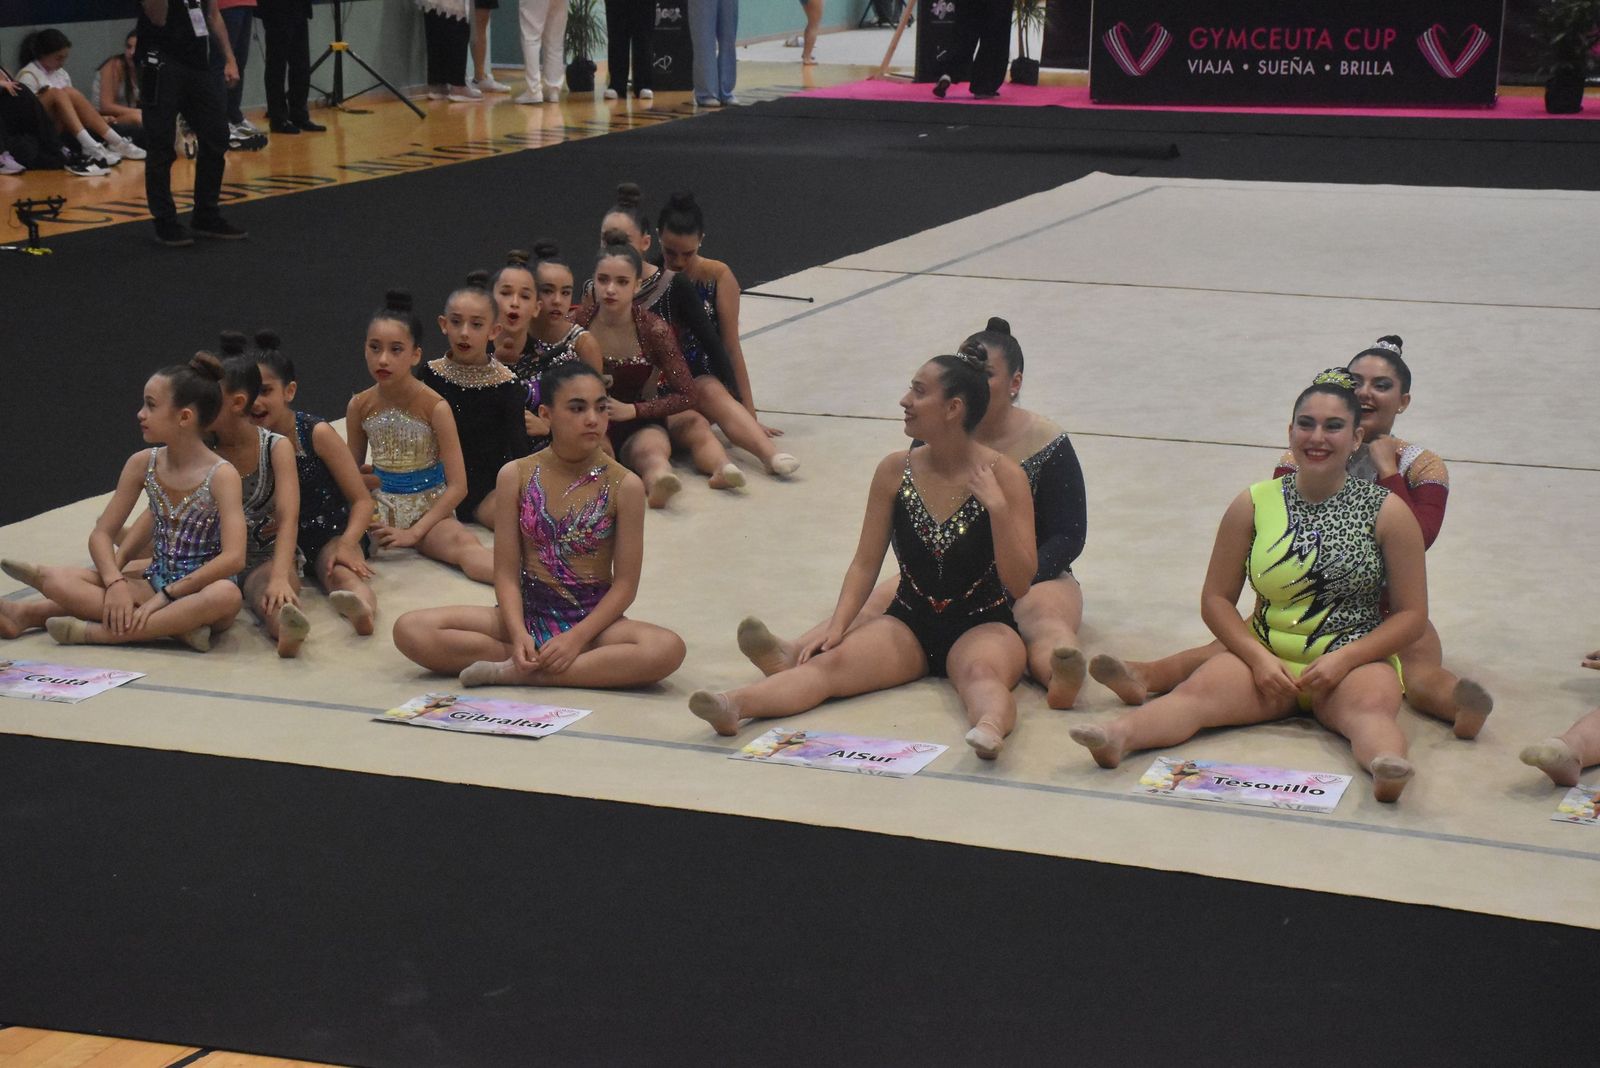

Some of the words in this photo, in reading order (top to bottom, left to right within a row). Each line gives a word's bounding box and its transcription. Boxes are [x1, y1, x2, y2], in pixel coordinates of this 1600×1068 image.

[1188, 26, 1333, 51] GYMCEUTA
[1344, 27, 1398, 51] CUP
[1187, 59, 1235, 75] VIAJA
[1257, 56, 1316, 75] SUEÑA
[1340, 60, 1395, 76] BRILLA
[23, 674, 89, 686] Ceuta
[449, 711, 555, 730] Gibraltar
[828, 750, 898, 763] AlSur
[1212, 776, 1326, 797] Tesorillo
